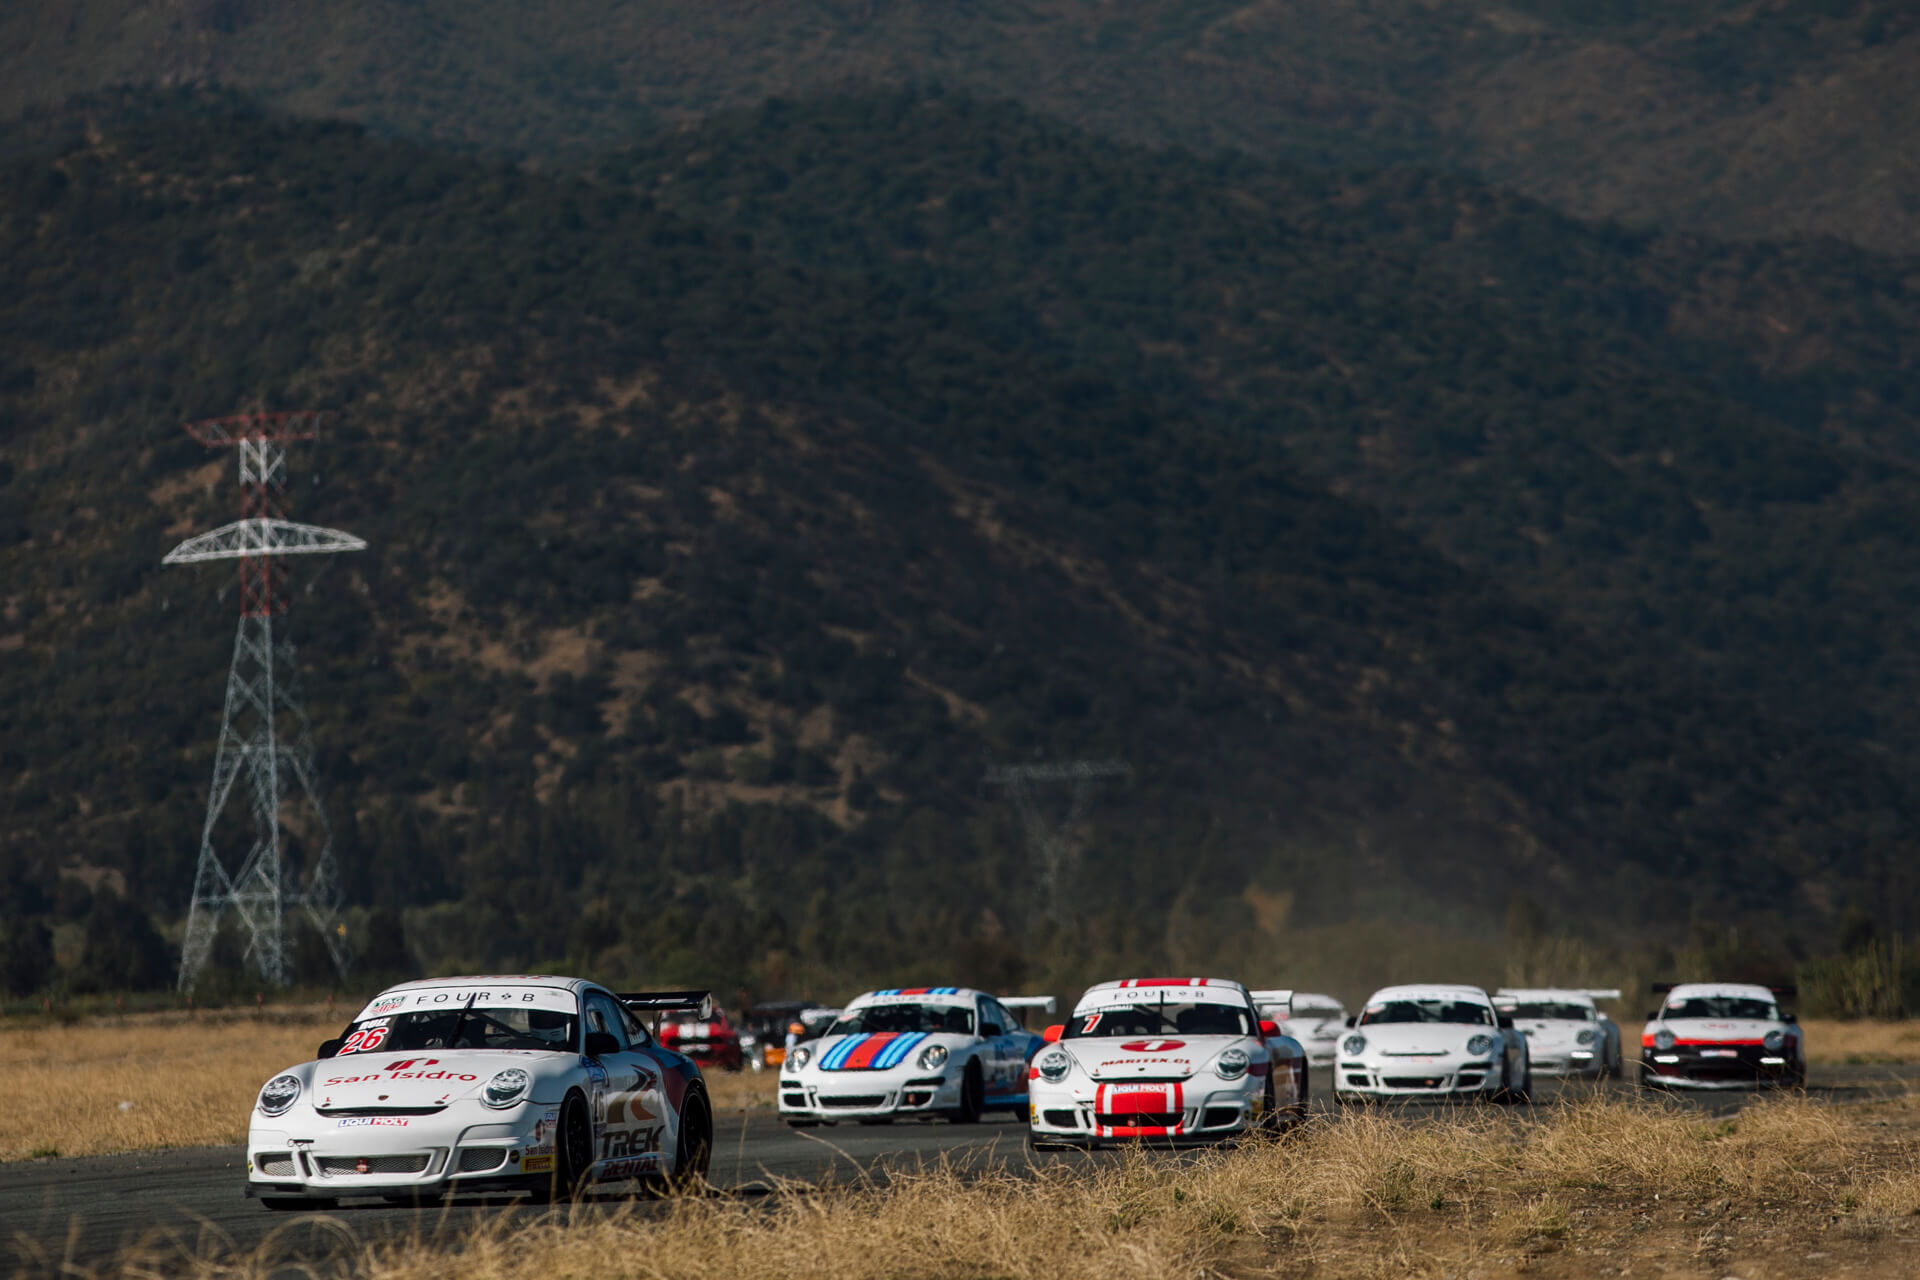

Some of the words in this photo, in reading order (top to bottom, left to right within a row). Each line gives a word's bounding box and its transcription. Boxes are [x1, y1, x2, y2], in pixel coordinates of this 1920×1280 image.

[416, 991, 491, 1005] FOUR
[521, 993, 535, 1002] B
[1081, 1012, 1103, 1034] 7
[339, 1026, 389, 1056] 26
[323, 1073, 379, 1086] San
[390, 1070, 477, 1081] Isidro
[338, 1119, 373, 1127] LIQUI
[374, 1118, 408, 1126] MOLY
[601, 1125, 665, 1158] TREK
[603, 1156, 658, 1176] RENTAL
